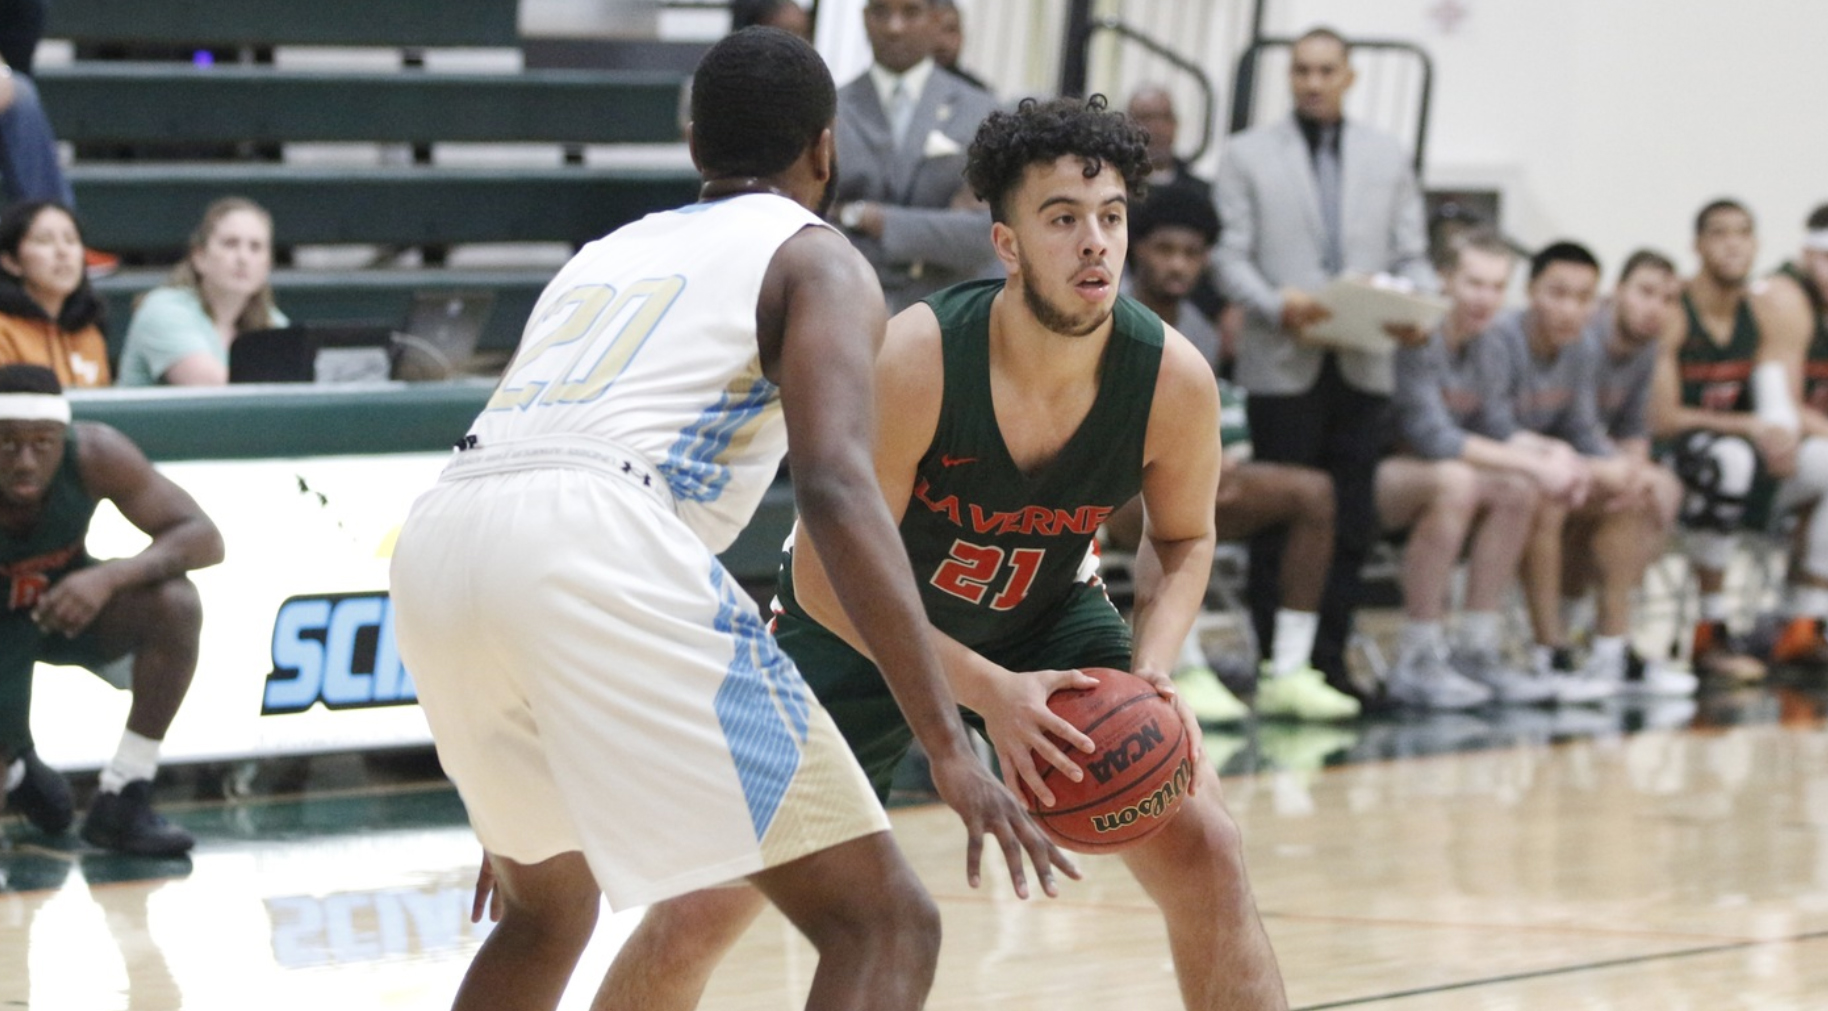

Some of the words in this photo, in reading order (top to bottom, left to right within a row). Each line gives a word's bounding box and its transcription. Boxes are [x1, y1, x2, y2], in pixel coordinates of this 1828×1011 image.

[487, 274, 687, 412] 20
[969, 504, 1114, 535] VERNE
[929, 538, 1046, 611] 21
[263, 592, 419, 714] SCI
[1087, 719, 1164, 785] NCAA
[1091, 757, 1191, 832] Wilson
